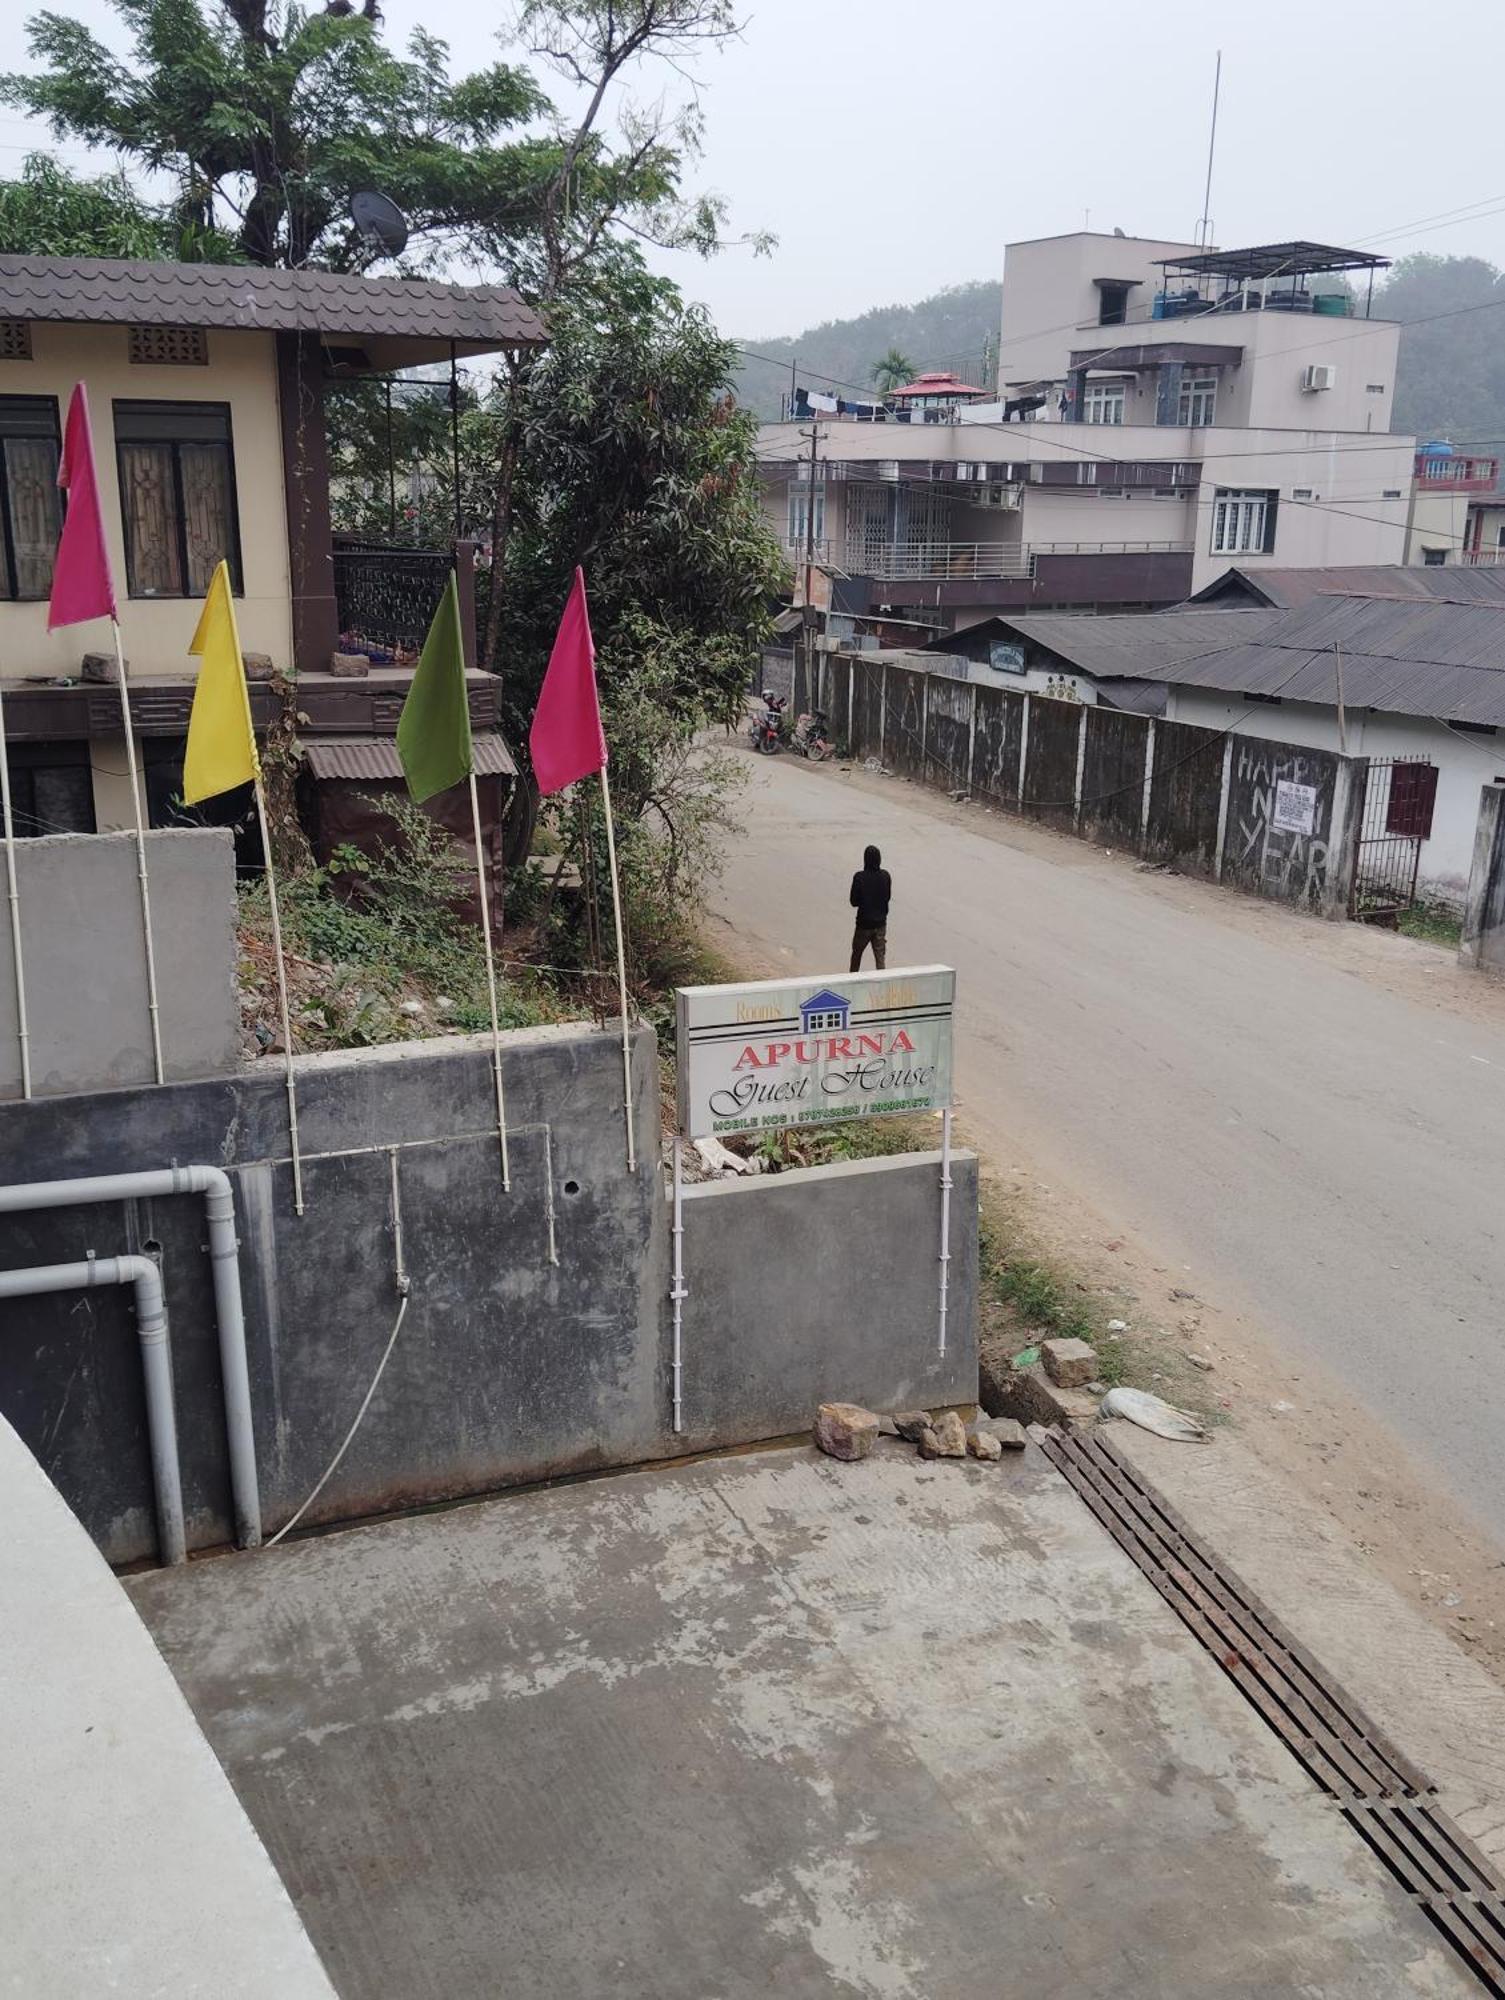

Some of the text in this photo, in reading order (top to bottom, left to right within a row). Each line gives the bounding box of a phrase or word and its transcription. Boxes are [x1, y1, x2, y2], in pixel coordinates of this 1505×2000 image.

[1239, 815, 1331, 902] YEAR
[732, 1029, 916, 1071] APURNA
[709, 1058, 935, 1118] Guest House
[712, 1114, 759, 1132] MOBILE
[762, 1112, 788, 1127] NOS
